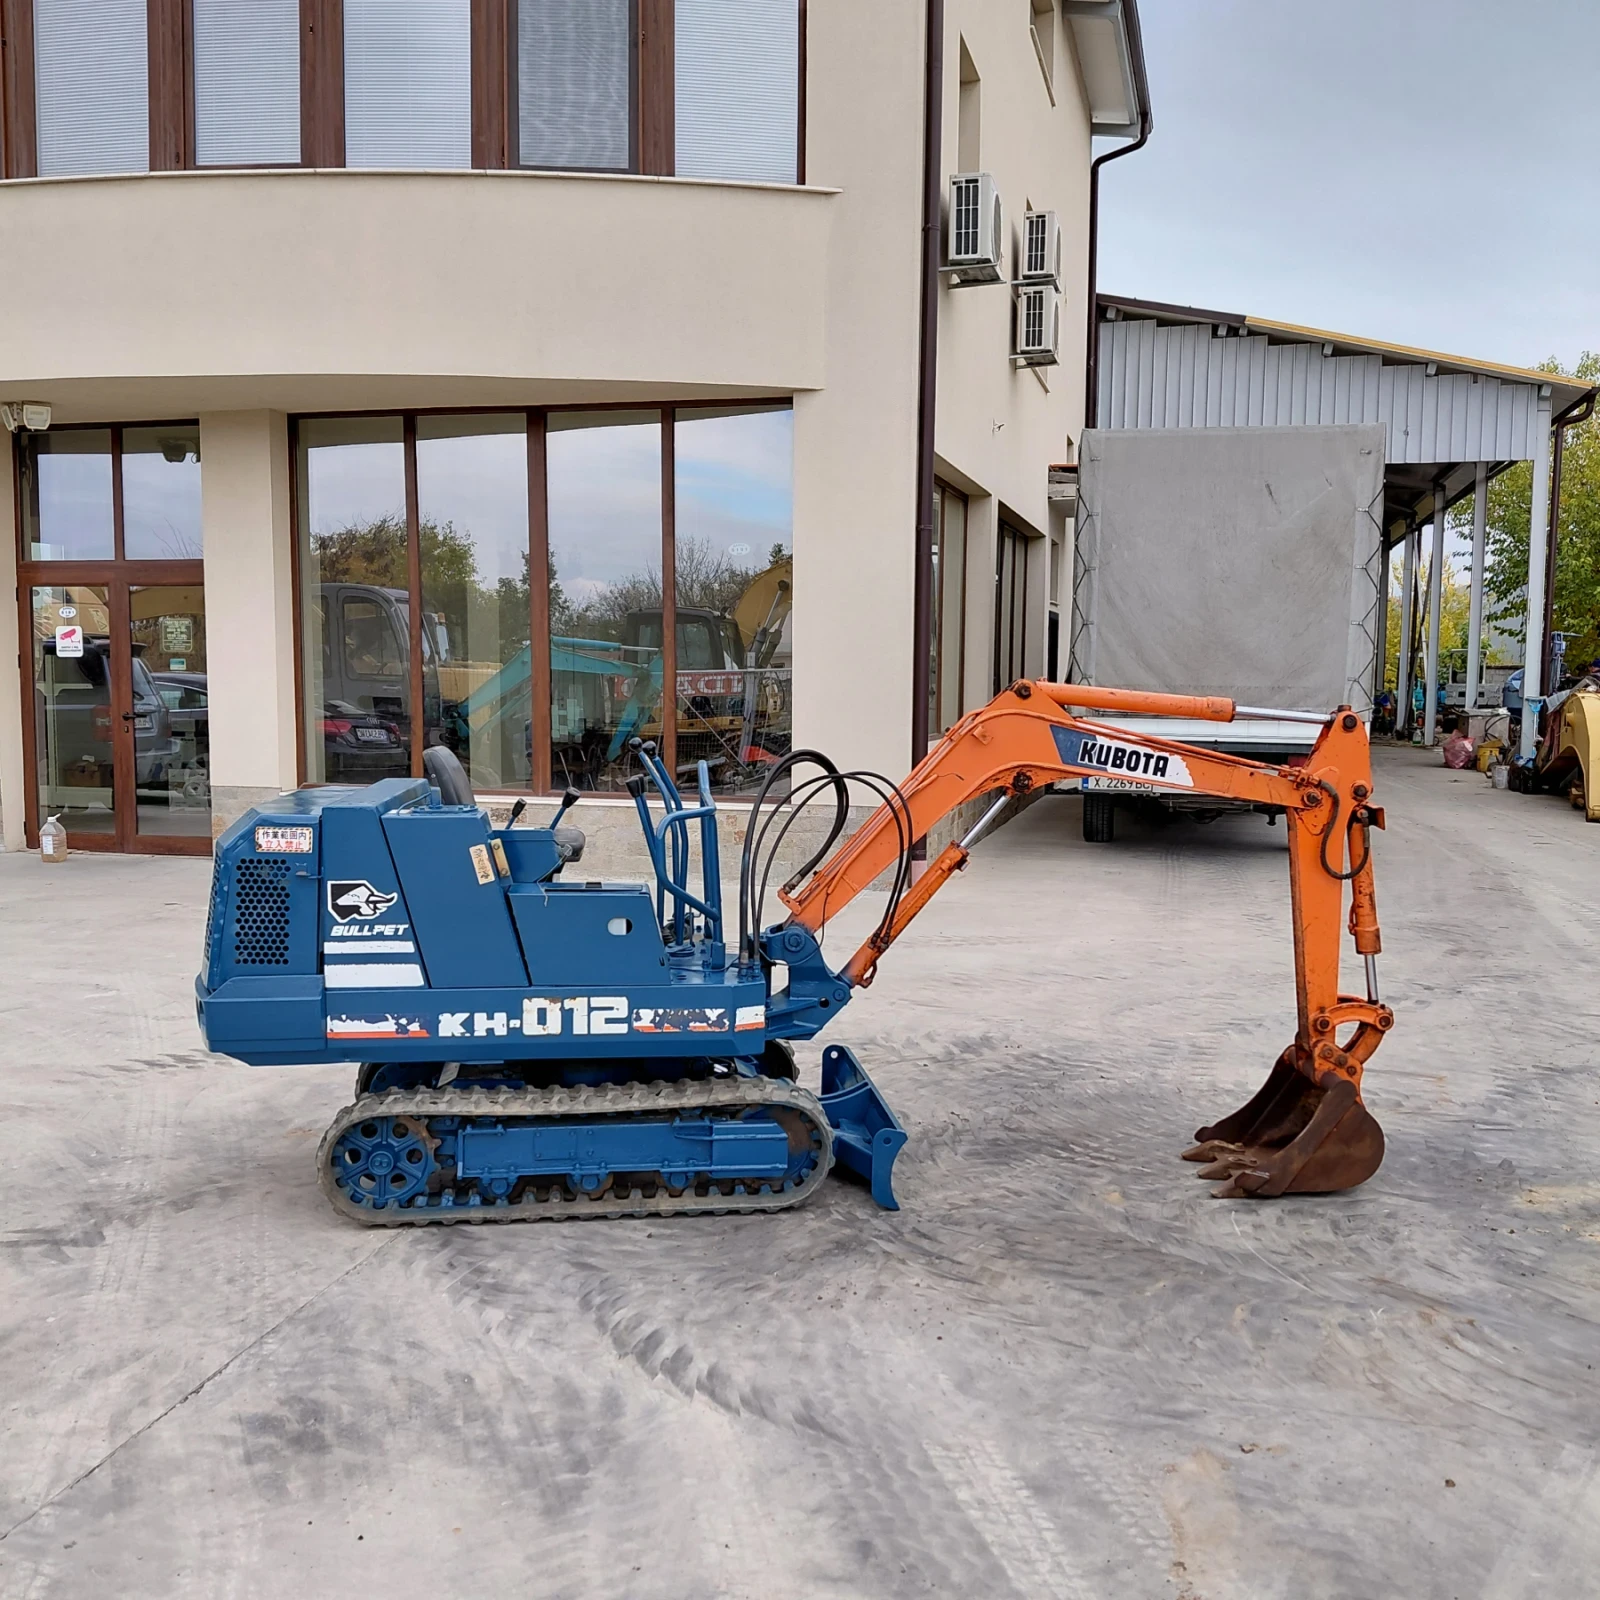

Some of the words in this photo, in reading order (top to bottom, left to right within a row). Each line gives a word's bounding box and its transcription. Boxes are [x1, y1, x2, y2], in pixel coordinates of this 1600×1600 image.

[1079, 740, 1169, 778] KUBOTA
[264, 840, 304, 850] 立入禁止
[330, 924, 409, 936] BULLPET
[438, 996, 629, 1036] KH-012
